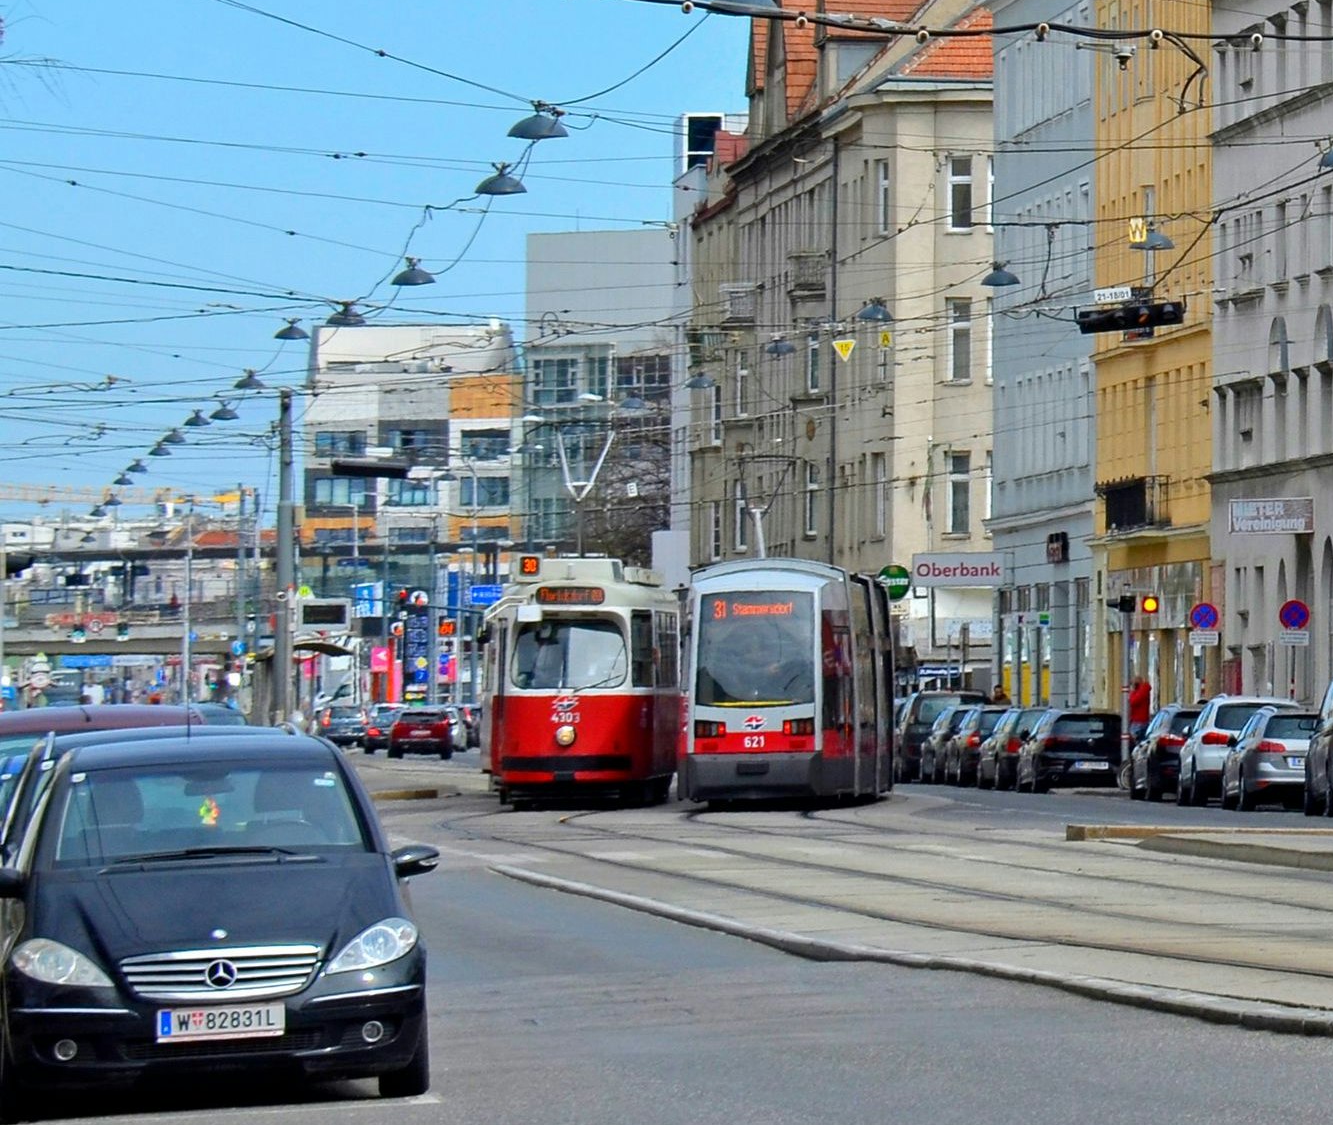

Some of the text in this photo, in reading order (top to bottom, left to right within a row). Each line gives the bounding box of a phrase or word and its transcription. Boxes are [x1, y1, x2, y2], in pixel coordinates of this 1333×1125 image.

[1233, 516, 1305, 532] Vereinigung
[523, 558, 537, 572] 30
[916, 562, 1001, 577] Oberbank
[713, 599, 793, 619] 31 Stammersdorf
[551, 711, 580, 723] 4303
[743, 736, 765, 748] 621
[177, 1008, 275, 1031] W 82831L
